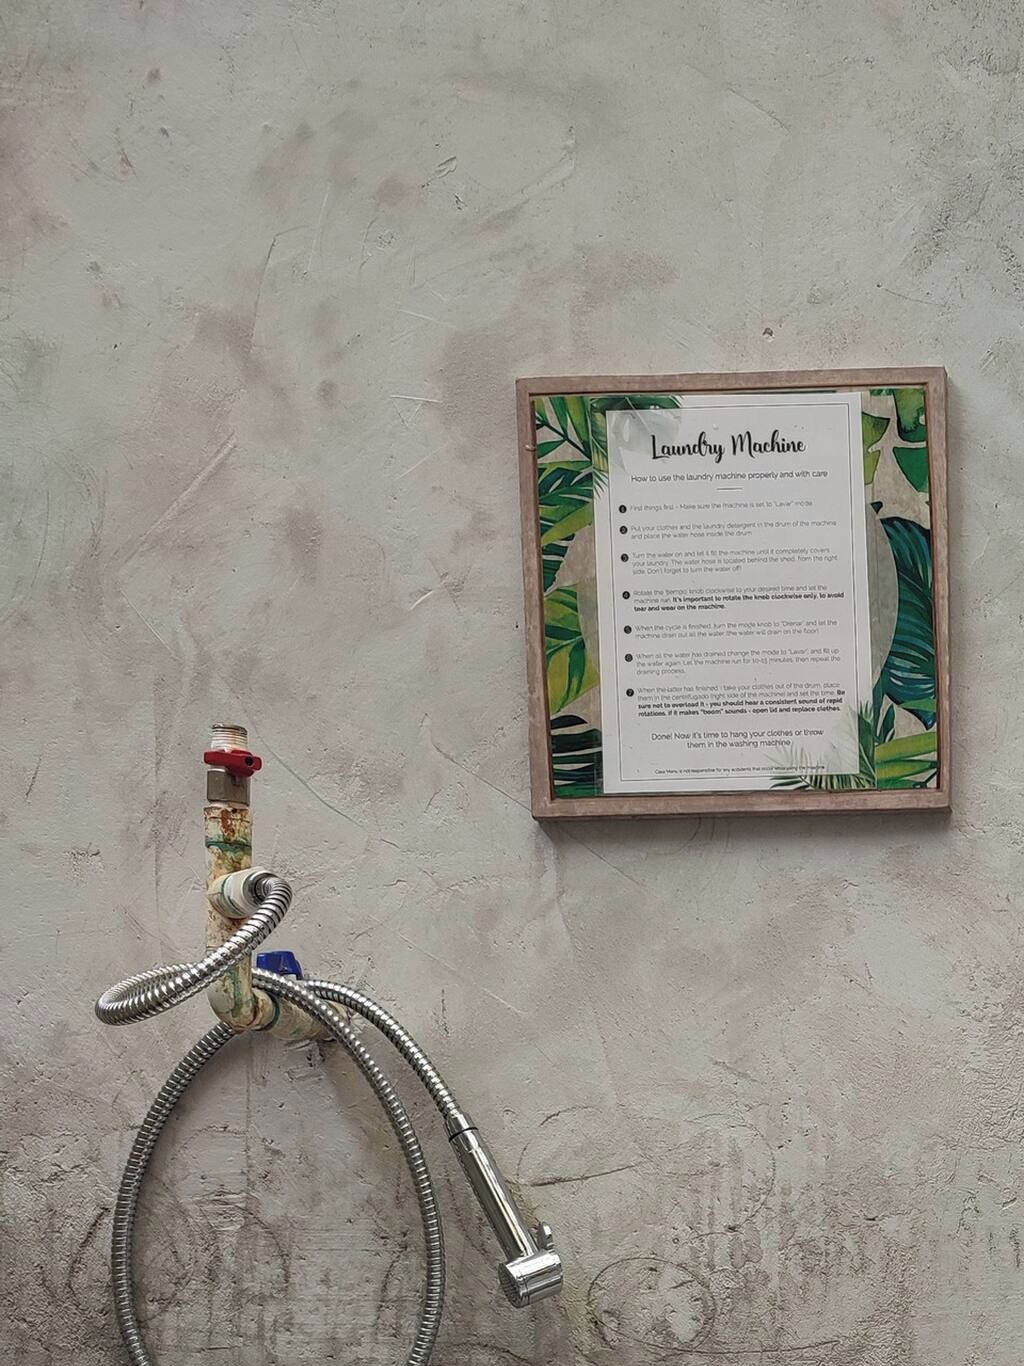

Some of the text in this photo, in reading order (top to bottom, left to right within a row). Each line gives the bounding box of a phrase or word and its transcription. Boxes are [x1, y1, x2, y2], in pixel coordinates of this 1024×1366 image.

[650, 429, 807, 464] Laundry Machine
[686, 473, 714, 482] laundry
[715, 472, 746, 480] machine
[748, 472, 778, 480] properly
[730, 731, 748, 739] hang
[749, 731, 765, 739] your
[729, 740, 758, 748] washing
